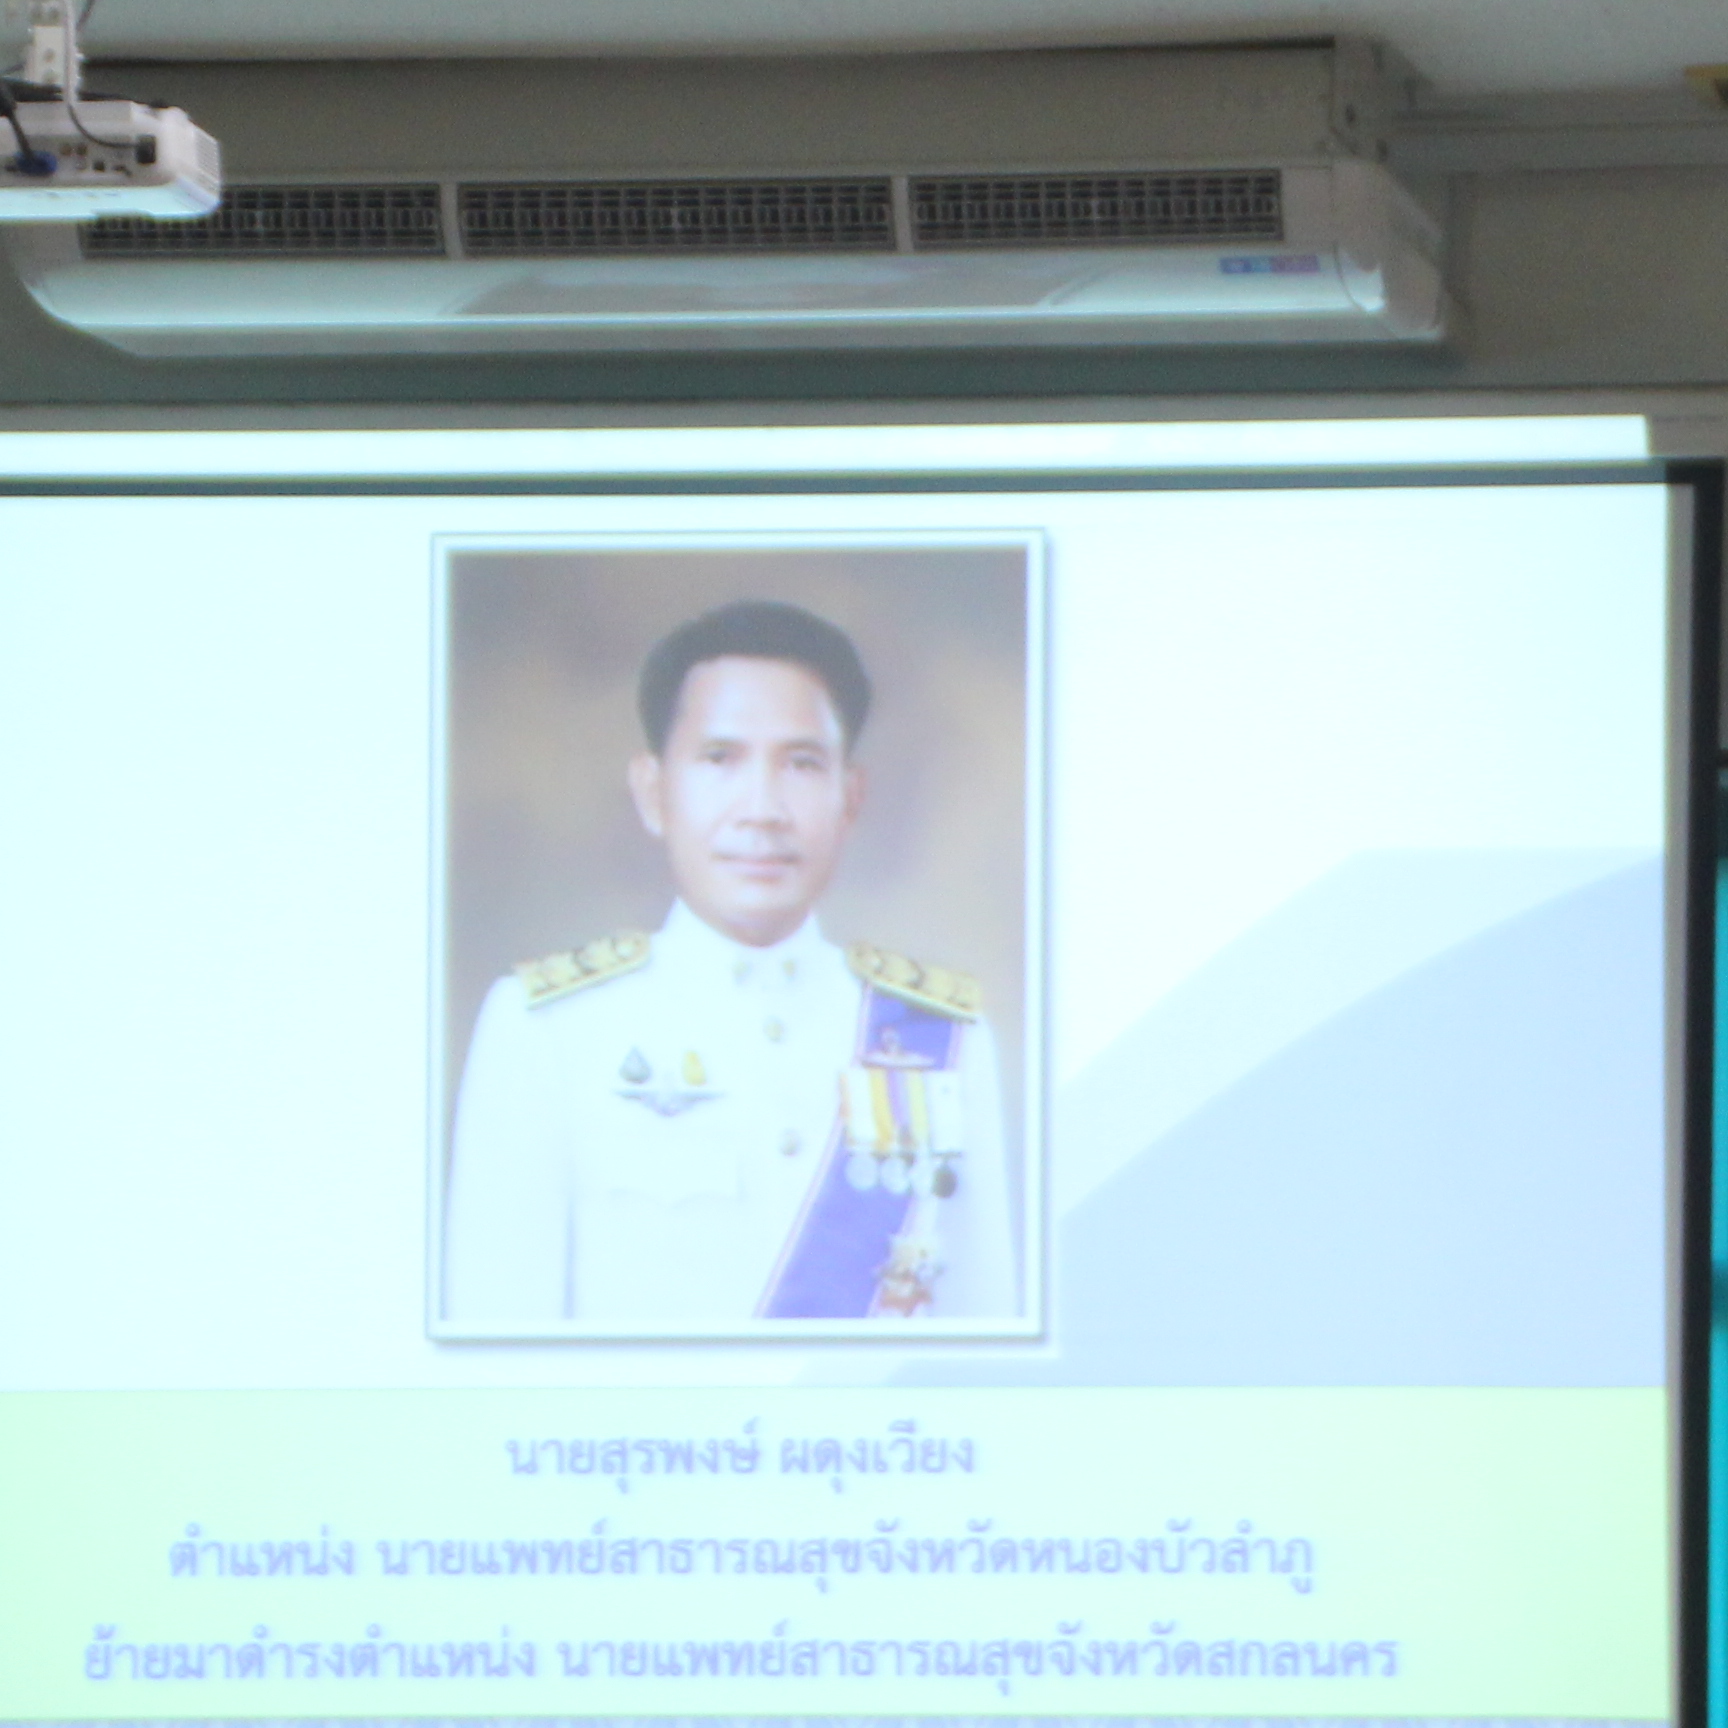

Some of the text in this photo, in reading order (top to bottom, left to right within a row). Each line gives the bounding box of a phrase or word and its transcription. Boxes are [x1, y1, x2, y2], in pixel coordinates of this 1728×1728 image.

[506, 1417, 976, 1494] นายสุรพงษ์ ผดุงเวียง
[169, 1518, 1314, 1595] ตำแหน่ง นายแพทย์สาธารณสุขจังหวัดหนองบัวลำภู
[84, 1620, 1401, 1697] ย้ายมาดำรงตำแหน่ง นายแพทย์สาธารณสุขจังหวัดสกลนคร
